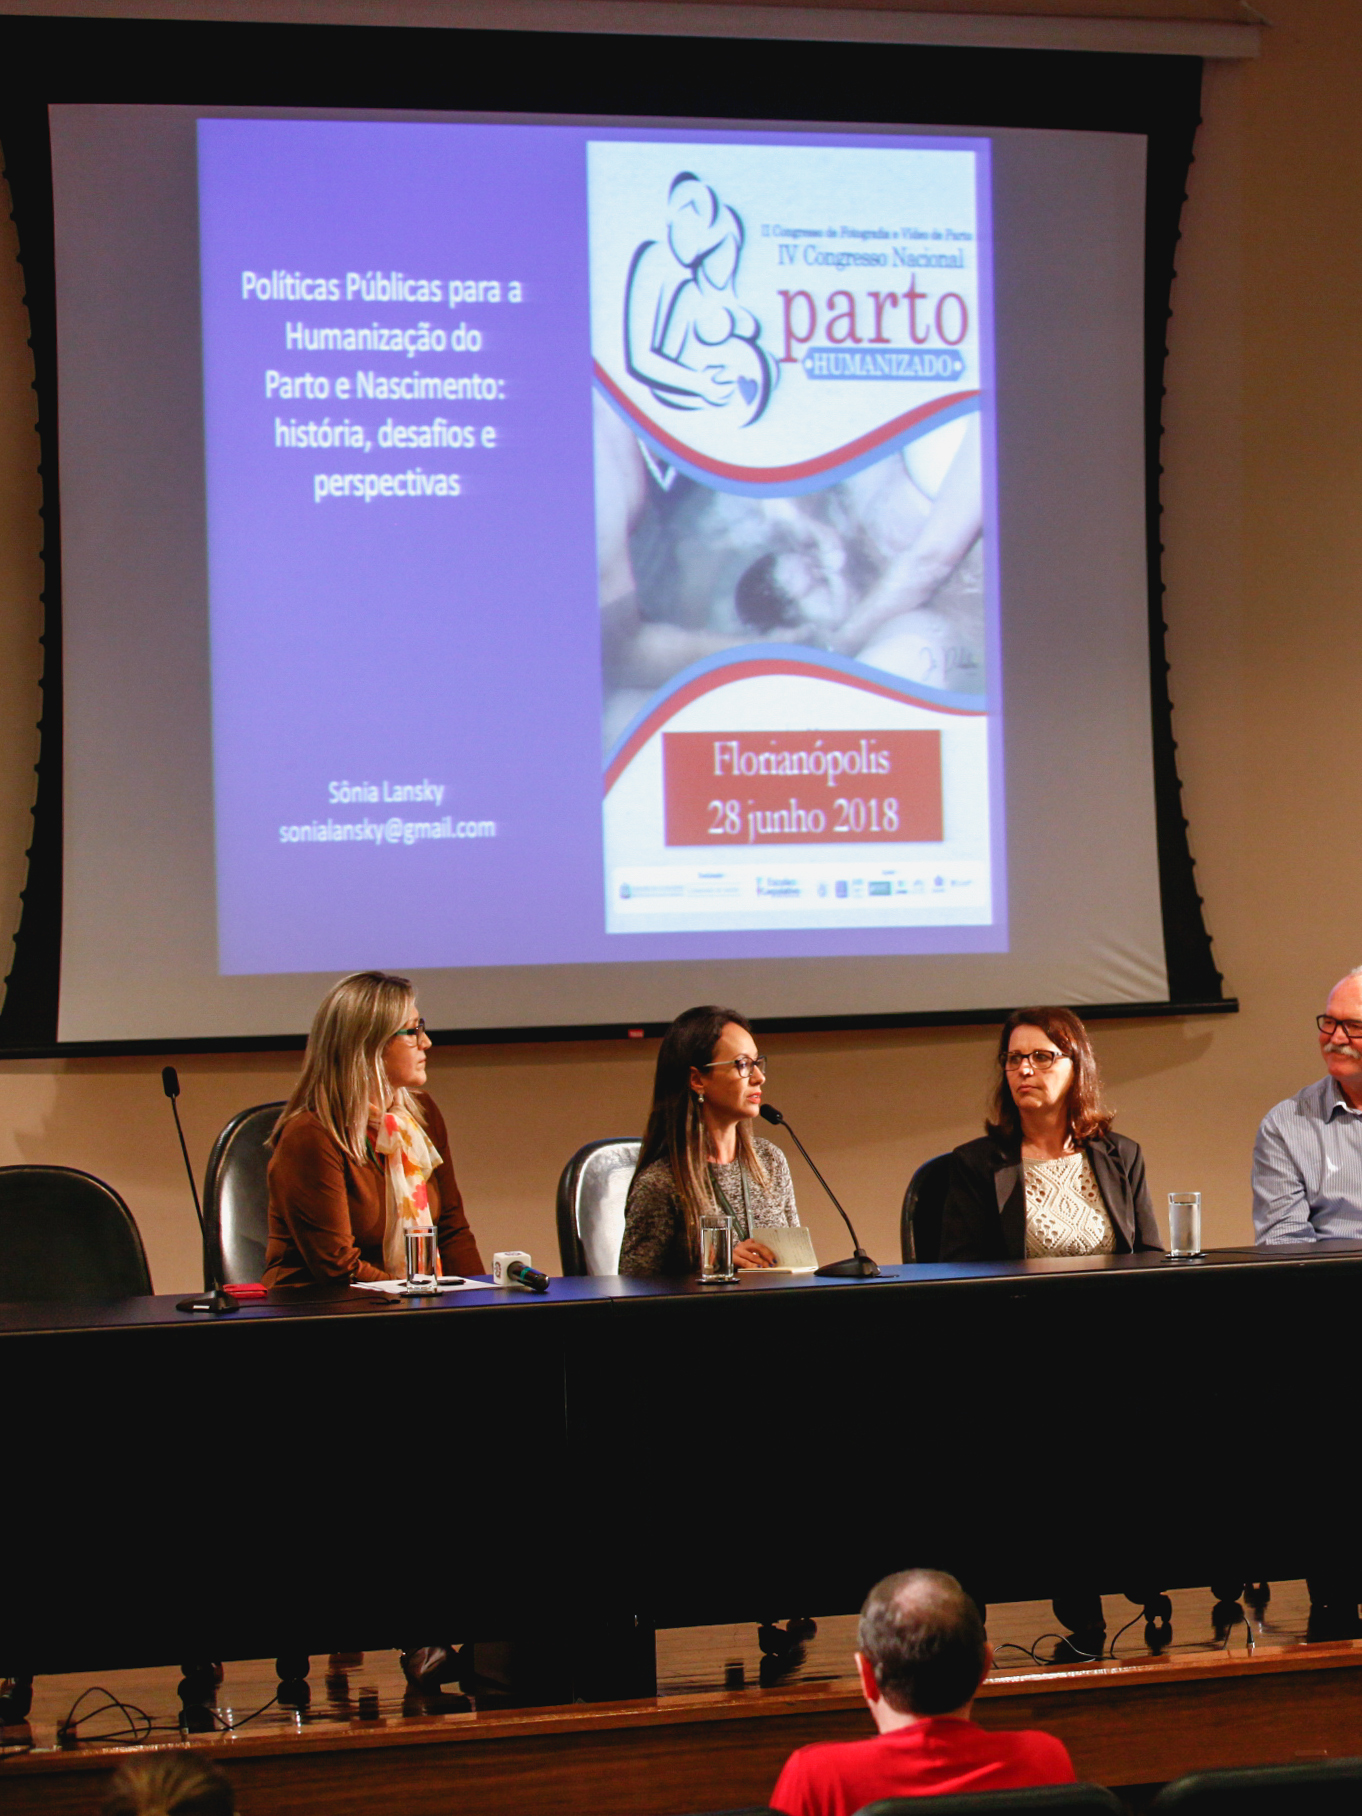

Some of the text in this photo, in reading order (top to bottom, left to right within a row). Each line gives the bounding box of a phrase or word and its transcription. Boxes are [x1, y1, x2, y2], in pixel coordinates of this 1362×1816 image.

[778, 243, 965, 271] IV Congresso Nacional
[241, 270, 523, 309] Políticas Públicas para a
[777, 271, 969, 363] parto
[285, 321, 482, 358] Humanização do
[812, 352, 953, 377] HUMANIZADO
[265, 370, 506, 401] Parto e Nascimento:
[274, 417, 498, 453] história, desafios e
[313, 467, 461, 503] perspectivas
[713, 738, 891, 787] Florianópolis
[327, 778, 446, 807] Sônia Lansky
[278, 815, 498, 846] sonialansky@gmail.com
[707, 797, 900, 845] 28 junho 2018
